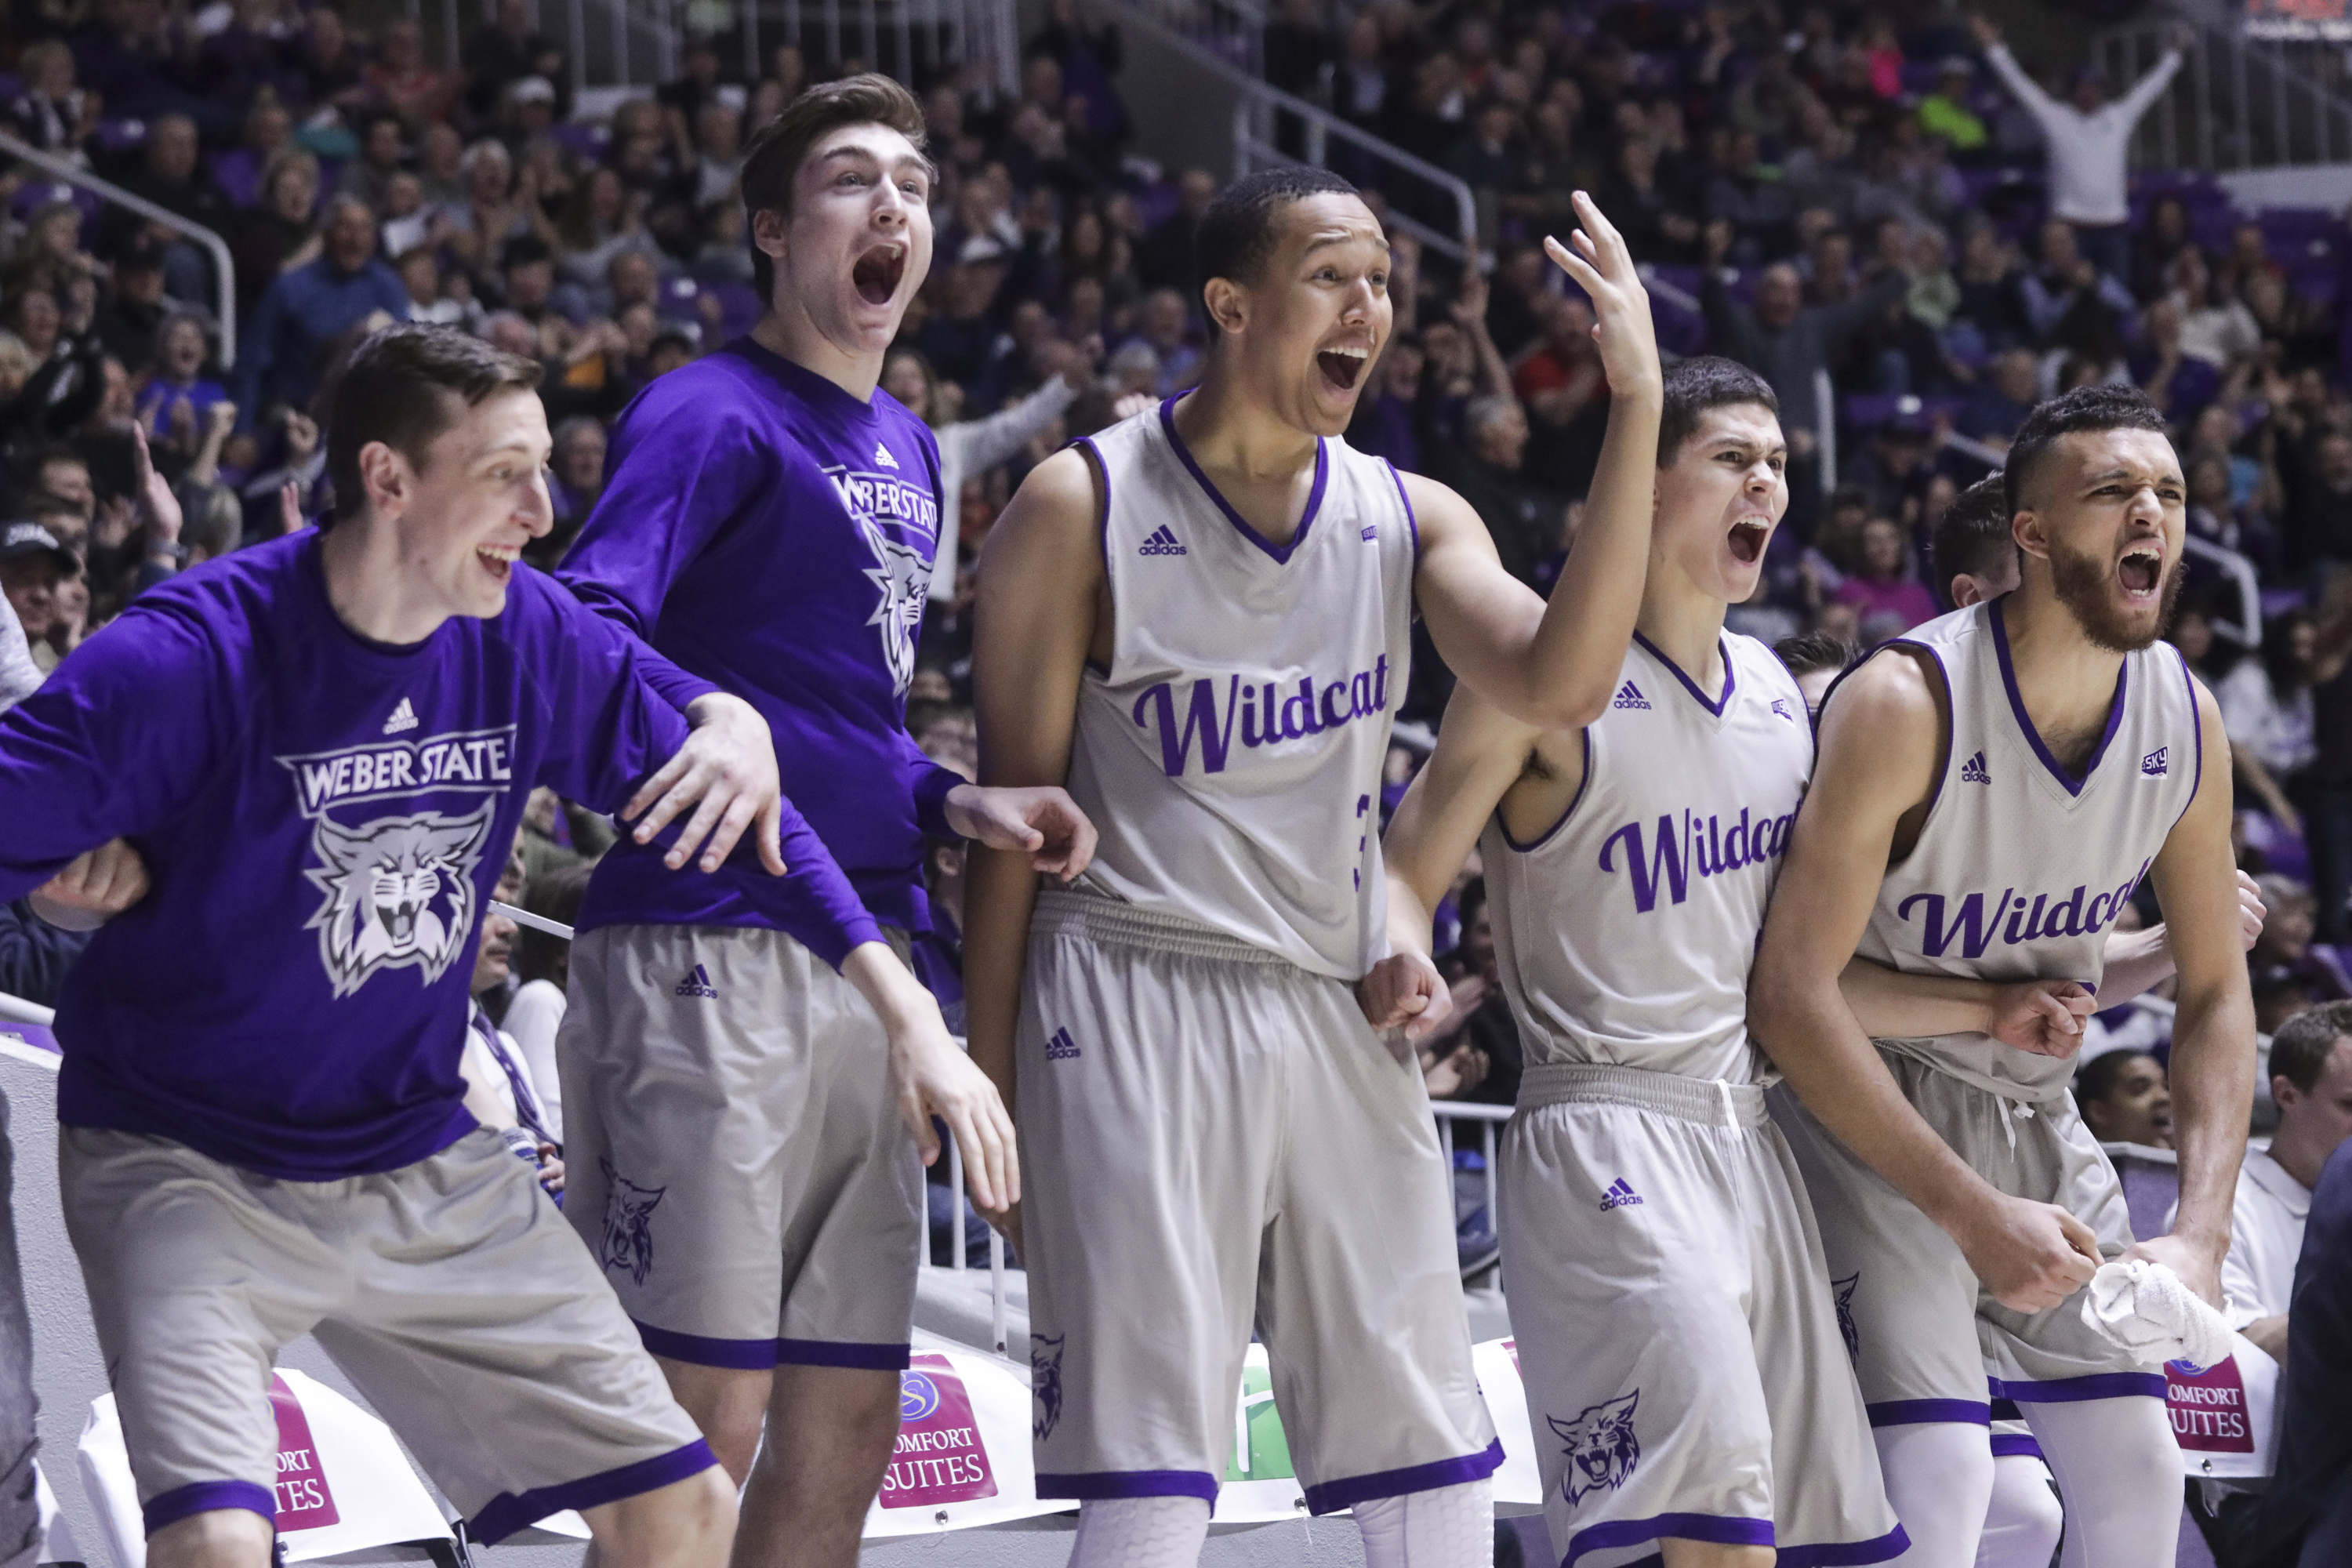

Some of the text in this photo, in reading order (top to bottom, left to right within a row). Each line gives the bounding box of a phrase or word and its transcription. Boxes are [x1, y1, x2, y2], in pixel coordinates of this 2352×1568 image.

[829, 474, 938, 535] WBER STAT
[1139, 543, 1187, 556] adidas
[1133, 653, 1388, 777] Wildcat
[1613, 697, 1652, 710] adidas
[382, 716, 419, 735] adidas
[2145, 748, 2167, 770] SKY
[303, 738, 512, 808] WEBER STATE
[676, 985, 718, 1000] adidas
[1599, 1195, 1643, 1212] adidas
[2168, 1383, 2240, 1406] OMFORT
[2166, 1407, 2245, 1439] UITES
[892, 1427, 974, 1454] OMFORT
[274, 1478, 325, 1514] TES
